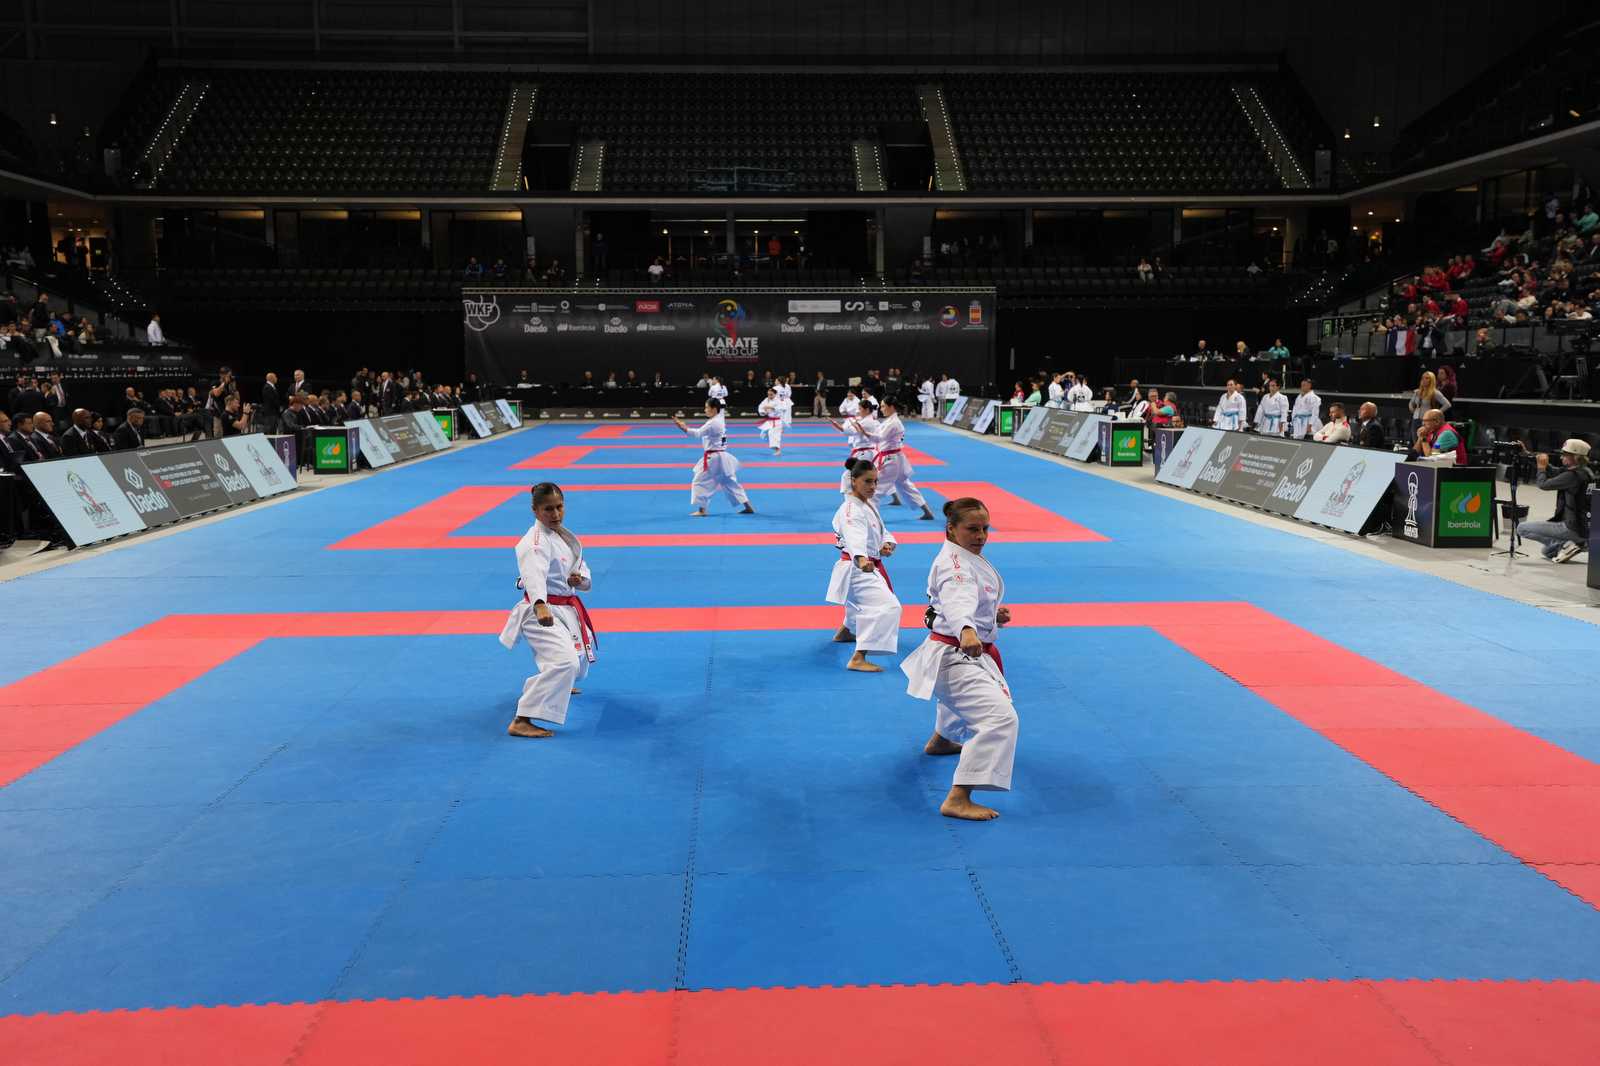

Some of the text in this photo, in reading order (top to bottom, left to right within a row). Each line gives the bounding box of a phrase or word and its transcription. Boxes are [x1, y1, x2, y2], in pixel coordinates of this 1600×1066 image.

[465, 303, 493, 316] WKF
[706, 337, 759, 348] KARATE
[706, 348, 759, 356] WORLD CUP
[1199, 460, 1226, 483] Daedo
[217, 470, 250, 492] Daedo
[1272, 476, 1307, 503] Daedo
[126, 488, 169, 514] Daedo
[1447, 520, 1481, 529] Iberdrola
